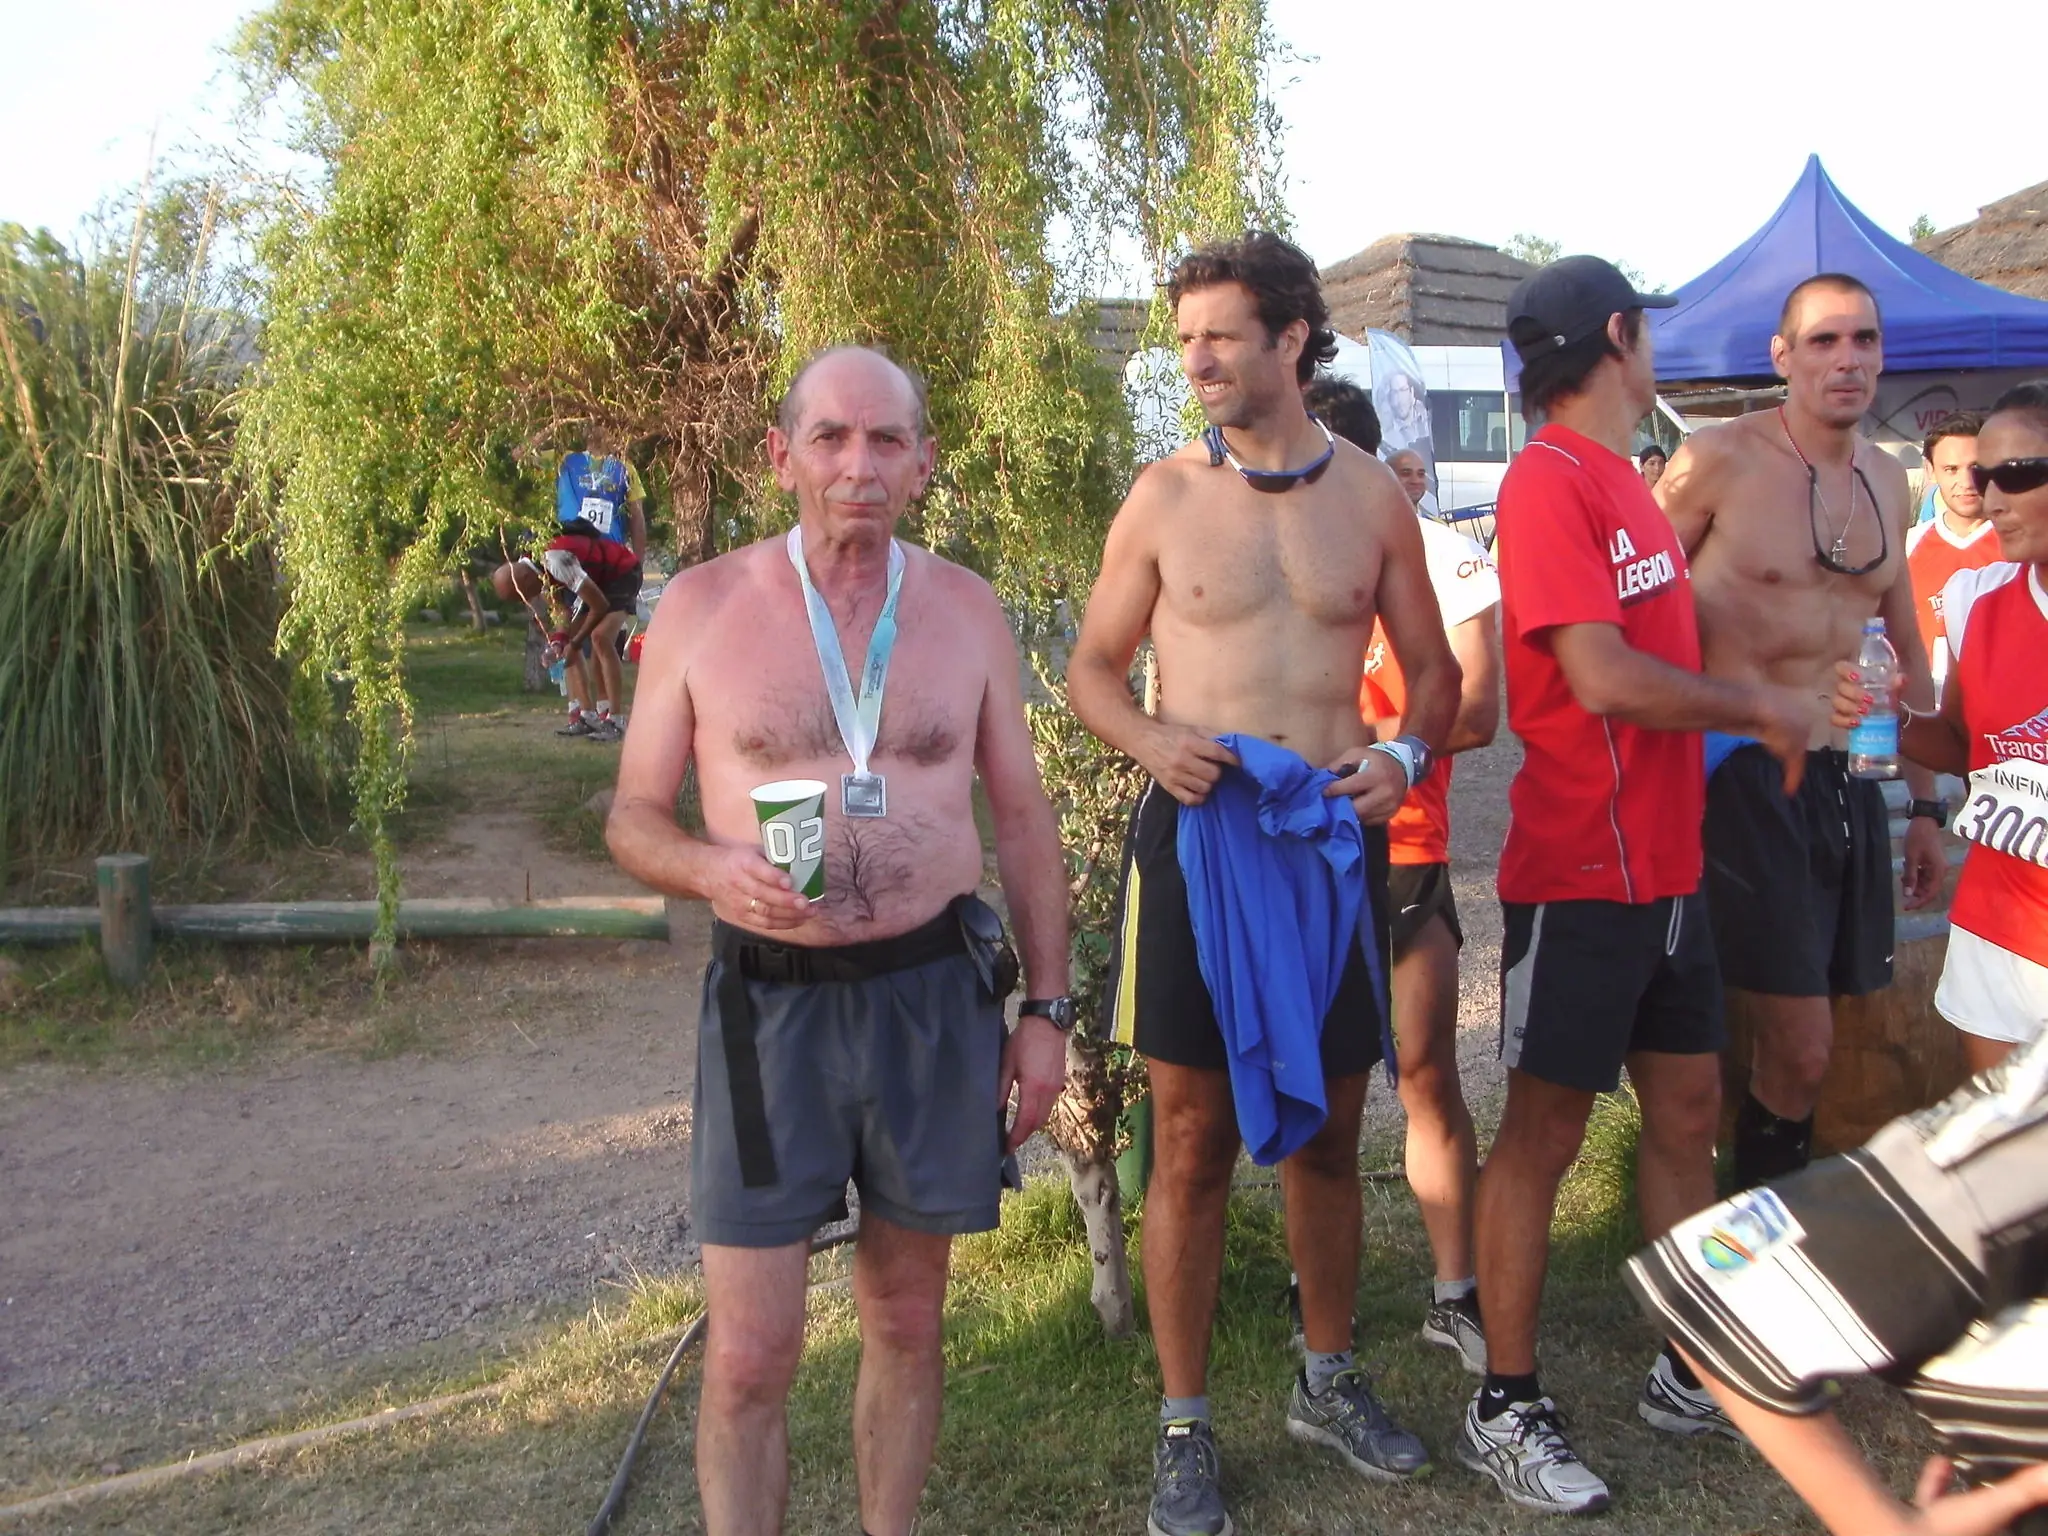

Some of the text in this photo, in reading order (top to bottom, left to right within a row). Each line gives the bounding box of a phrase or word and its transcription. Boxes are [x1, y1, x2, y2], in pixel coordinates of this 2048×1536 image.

[588, 509, 604, 525] 91
[1609, 528, 1636, 564] LA
[765, 817, 822, 864] 02
[1959, 793, 2048, 866] 300
